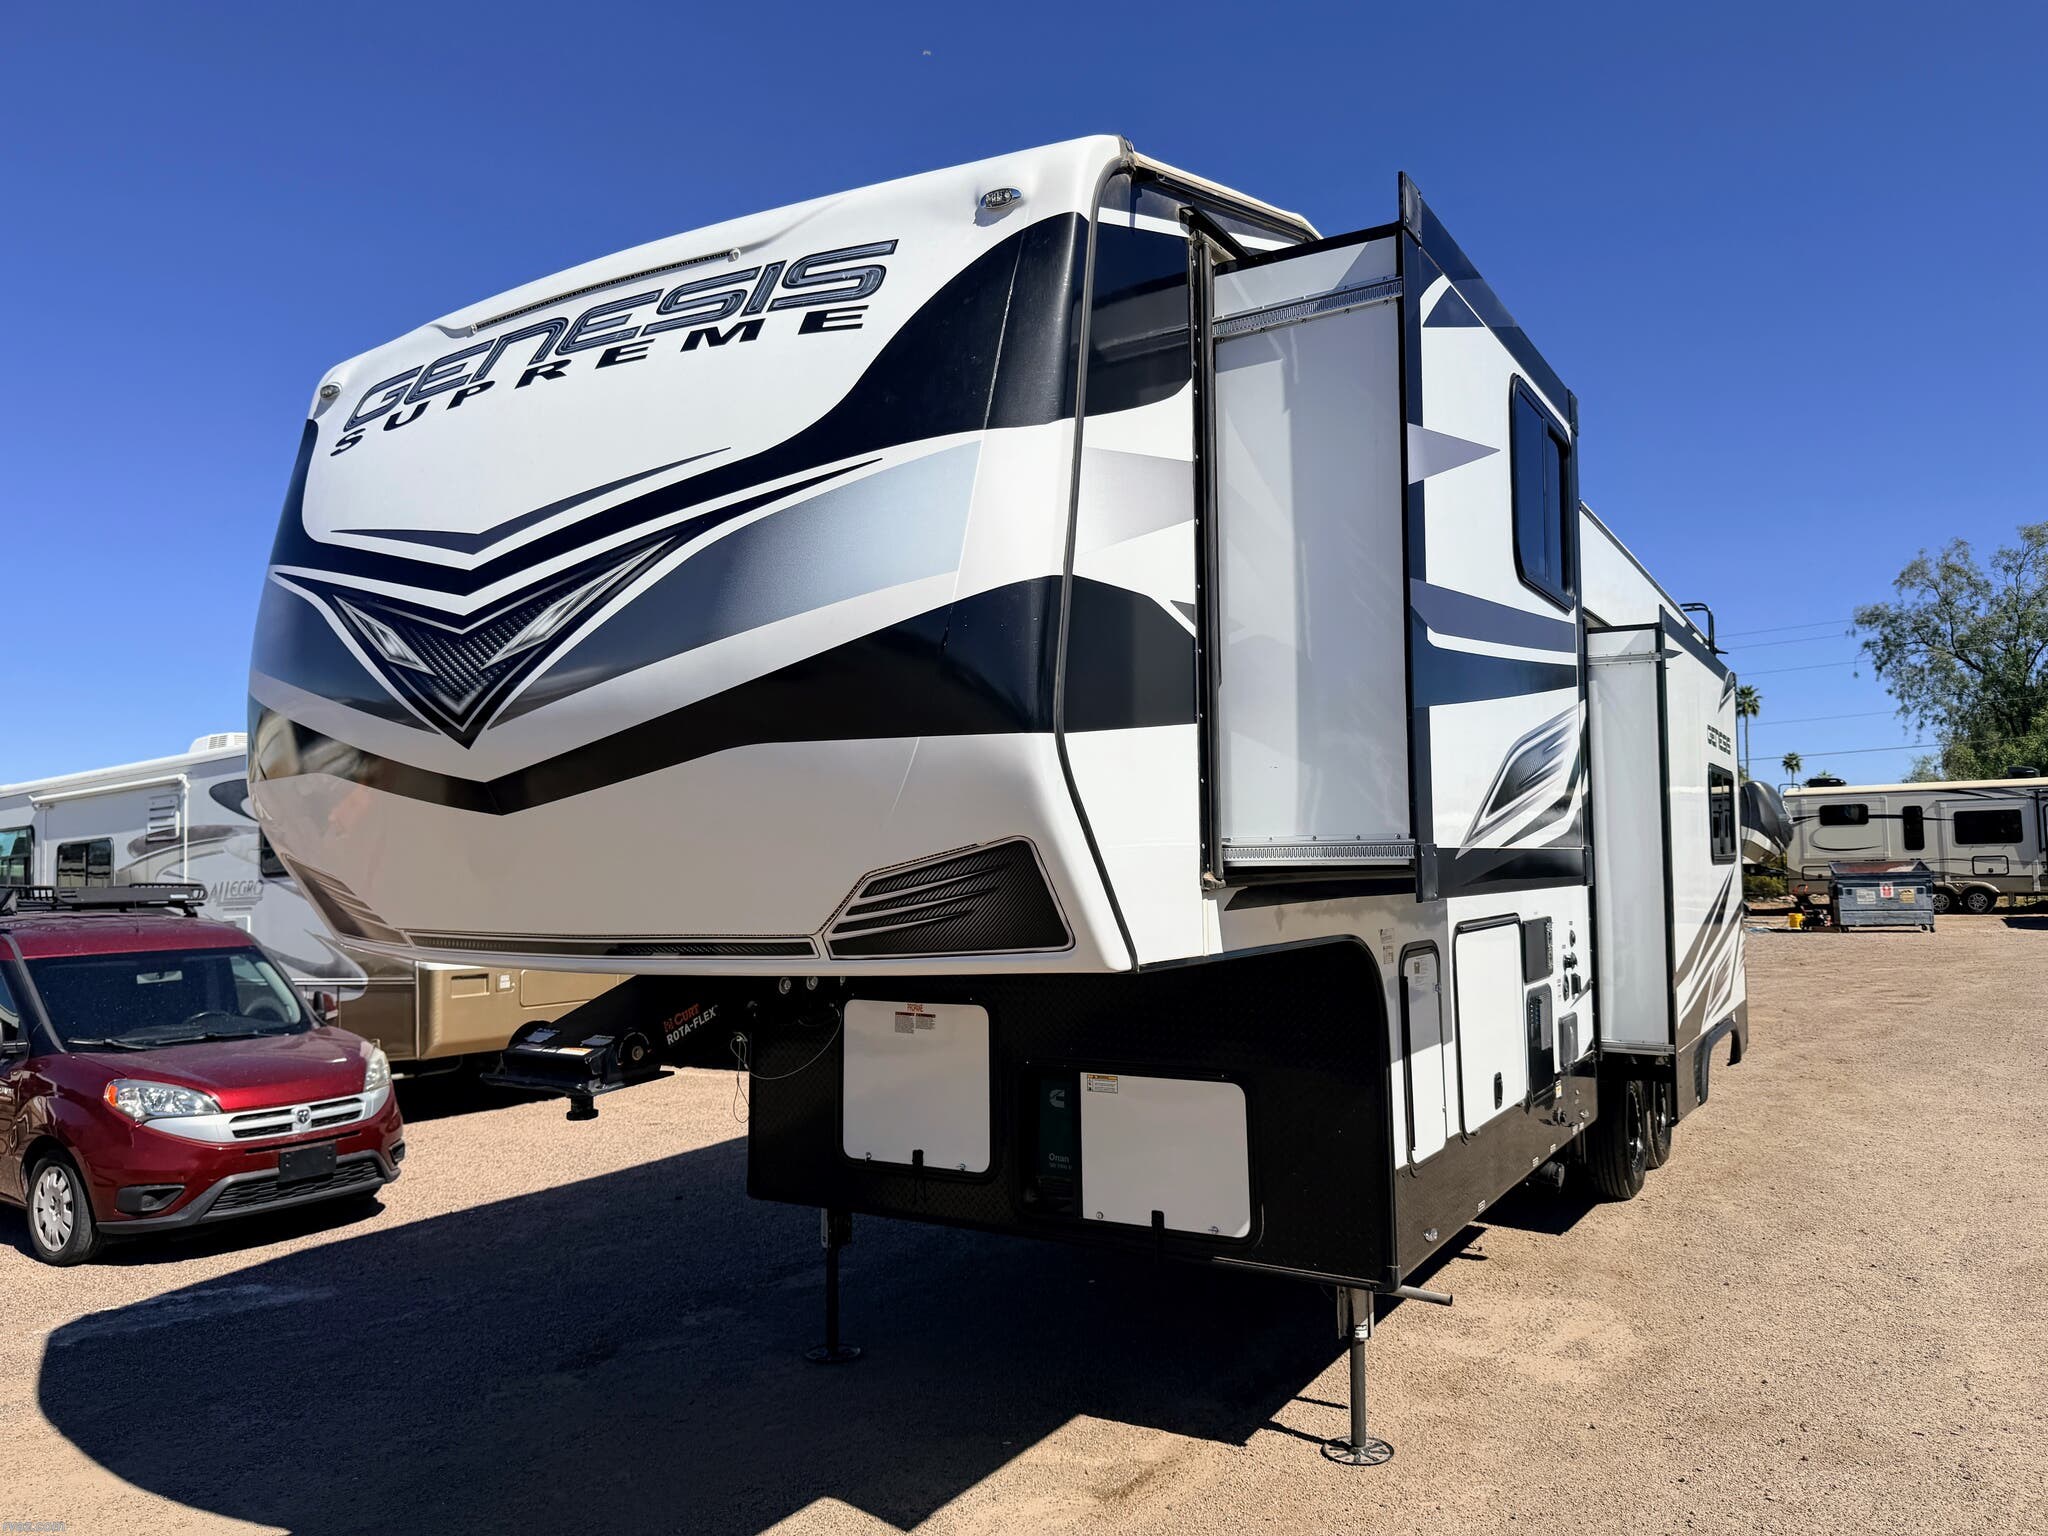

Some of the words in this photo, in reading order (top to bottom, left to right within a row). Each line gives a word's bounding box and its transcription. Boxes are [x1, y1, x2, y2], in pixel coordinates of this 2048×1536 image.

[342, 238, 898, 433] GENESIS
[330, 304, 869, 457] SUPREME
[207, 880, 264, 906] ALLEGRO
[673, 1001, 702, 1025] CURT
